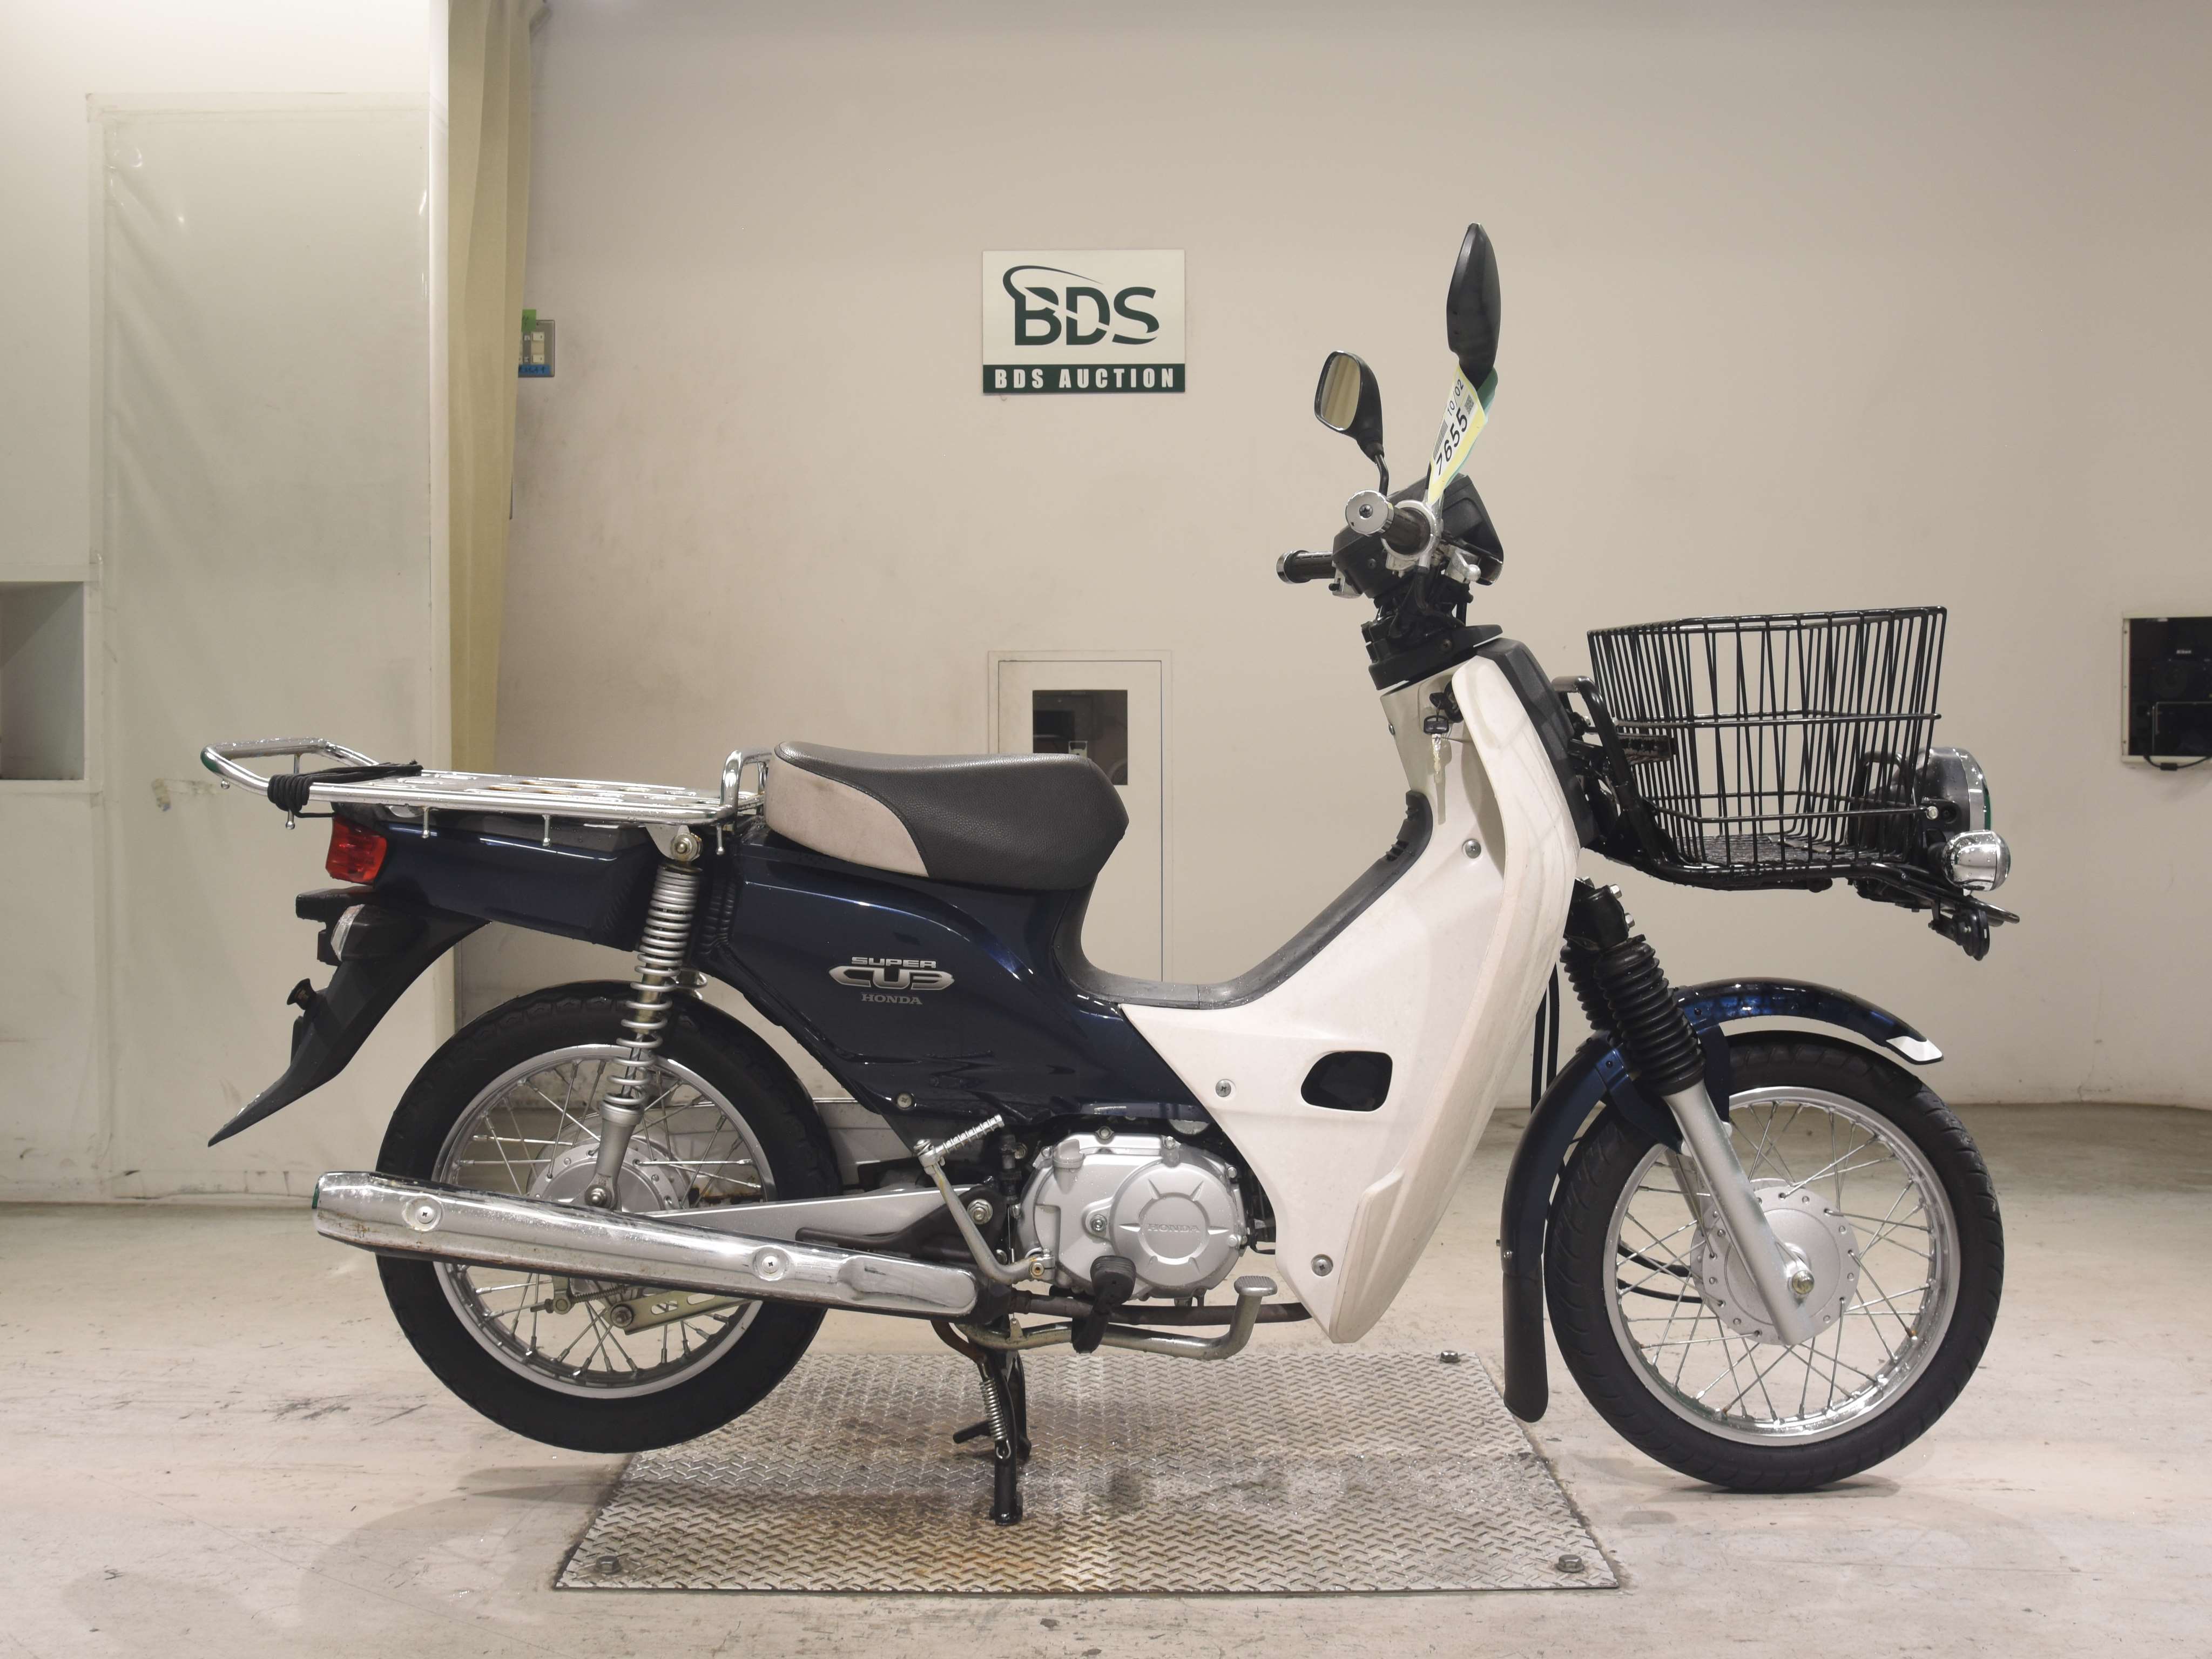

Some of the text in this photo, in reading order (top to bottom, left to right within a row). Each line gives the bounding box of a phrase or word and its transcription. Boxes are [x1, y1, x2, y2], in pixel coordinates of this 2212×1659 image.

[1003, 265, 1159, 345] BDS
[995, 368, 1174, 389] BDS AUCTION
[1447, 379, 1464, 416] 10/02
[1436, 407, 1468, 476] 7655
[851, 956, 936, 968] SUPER
[828, 966, 955, 990] CUB
[861, 993, 923, 1005] HONDA
[1145, 1223, 1201, 1233] HONDA
